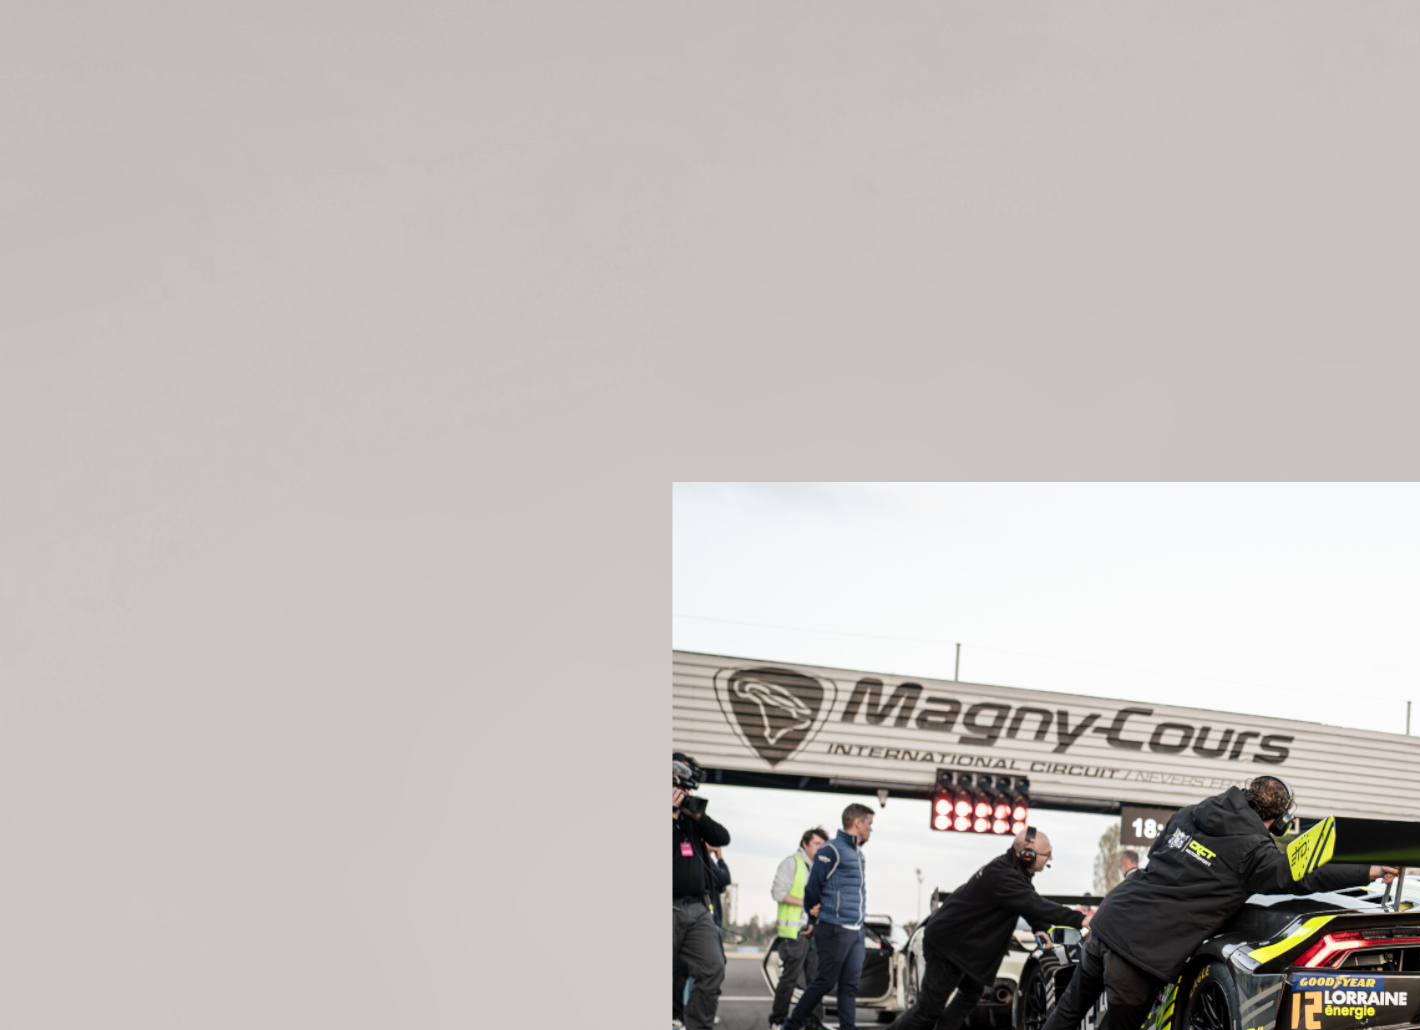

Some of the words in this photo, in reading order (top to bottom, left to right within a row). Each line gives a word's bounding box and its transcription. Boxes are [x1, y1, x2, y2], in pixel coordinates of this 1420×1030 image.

[841, 677, 1294, 765] Magny-Cours
[827, 743, 1022, 772] INTERNATIONAL
[1030, 762, 1121, 780] CIRCUIT
[1135, 770, 1204, 788] NEVERS
[1300, 975, 1376, 989] GOODYEAR
[1324, 990, 1408, 1006] LORRAINE
